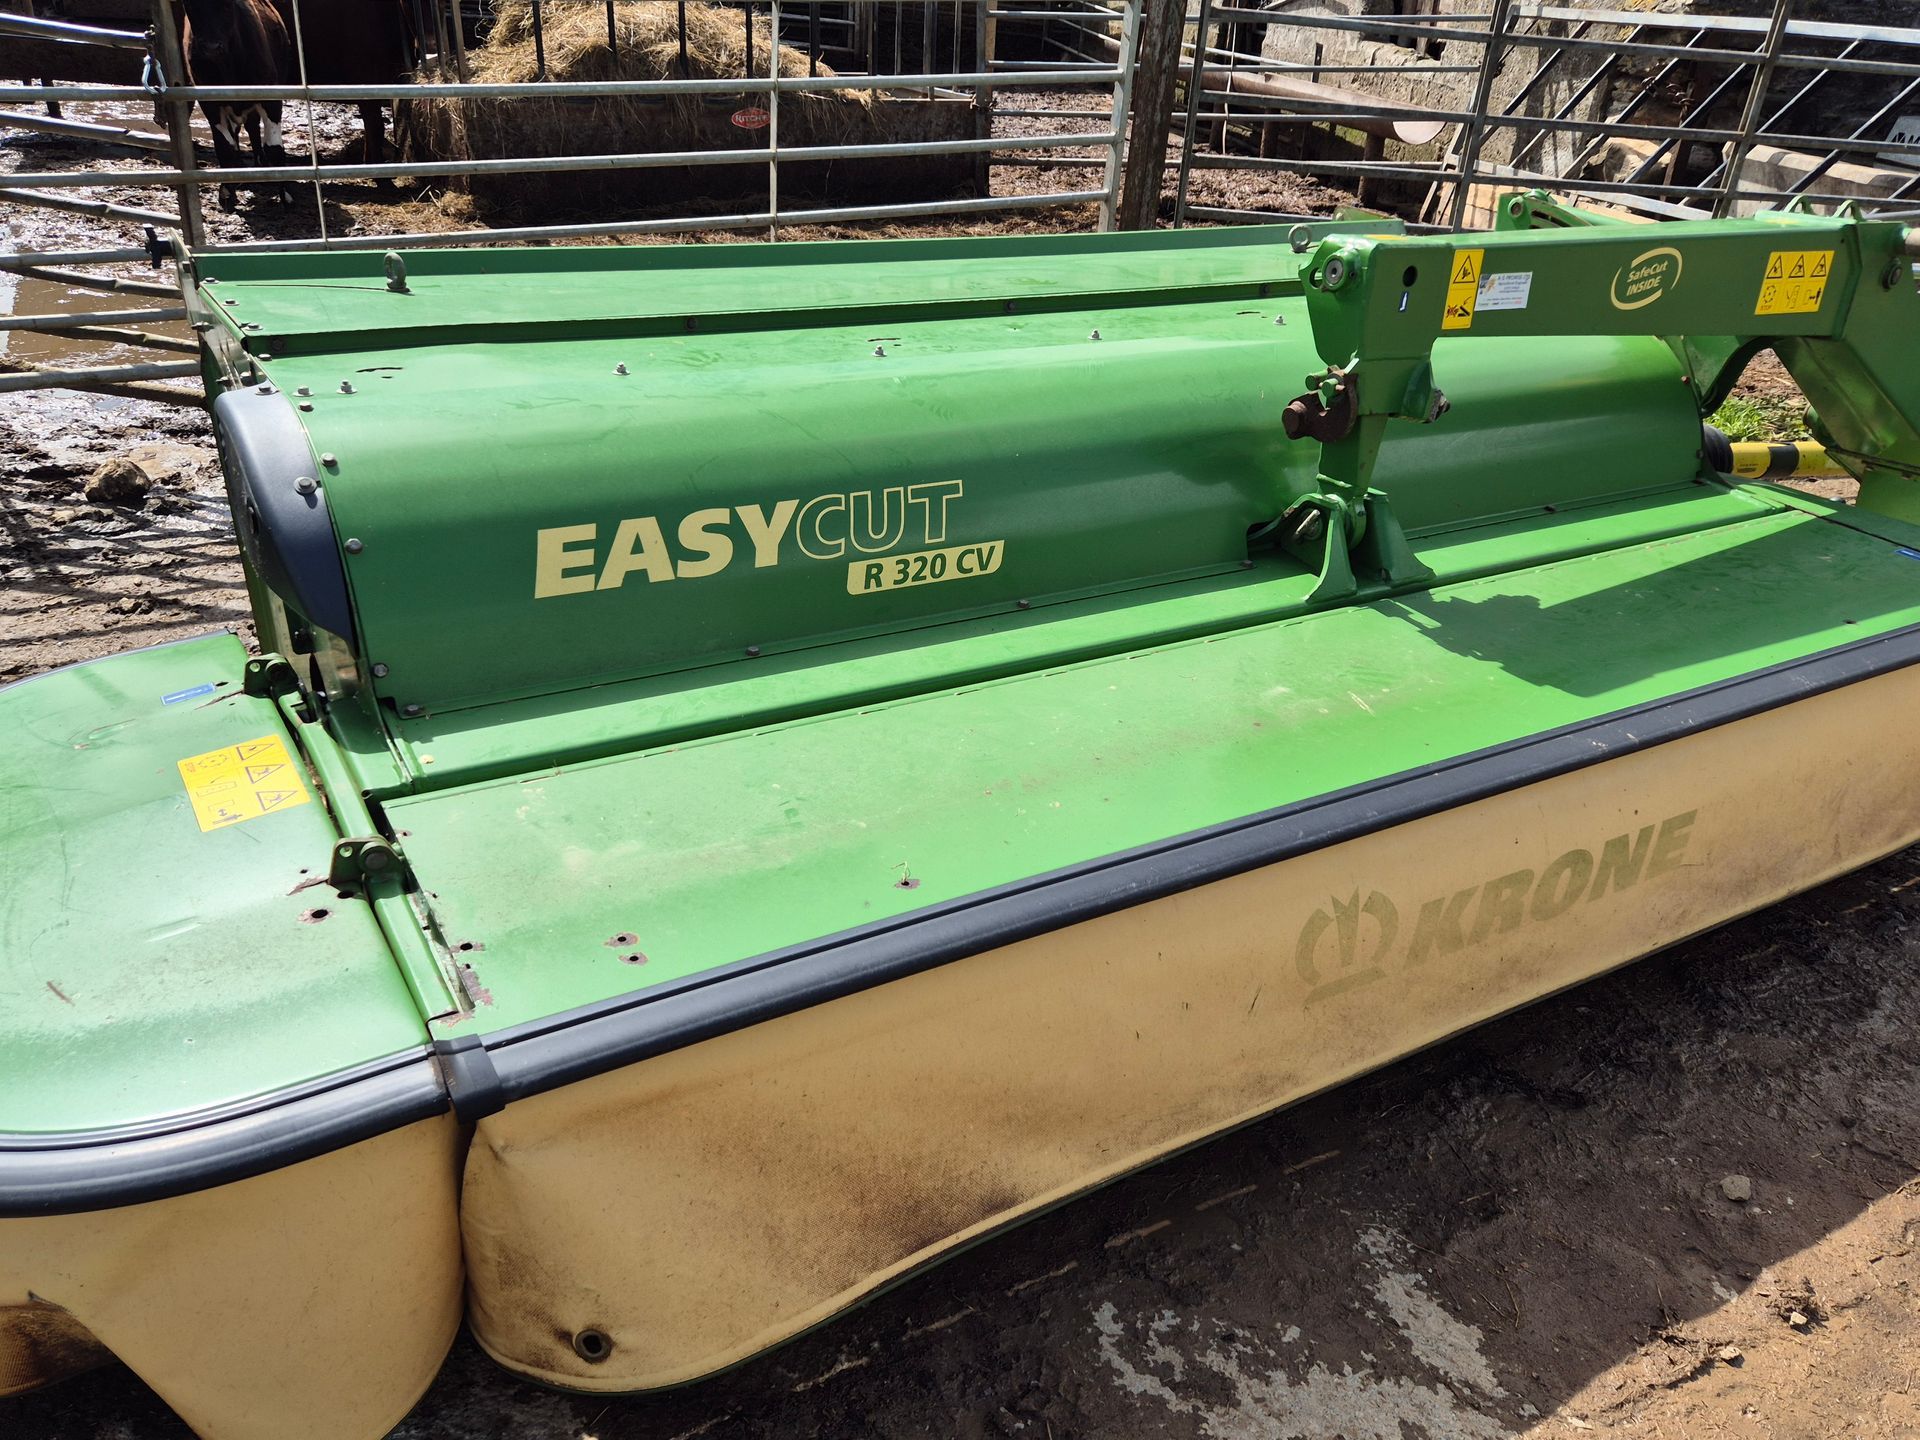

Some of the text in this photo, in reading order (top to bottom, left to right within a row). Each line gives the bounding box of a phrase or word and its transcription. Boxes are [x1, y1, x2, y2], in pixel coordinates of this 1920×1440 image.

[1626, 275, 1662, 296] INSIDE
[1627, 260, 1669, 282] SafeCut
[534, 479, 963, 599] EASYCUT
[863, 546, 996, 590] R 320 CV
[1403, 808, 1698, 971] KRONE
